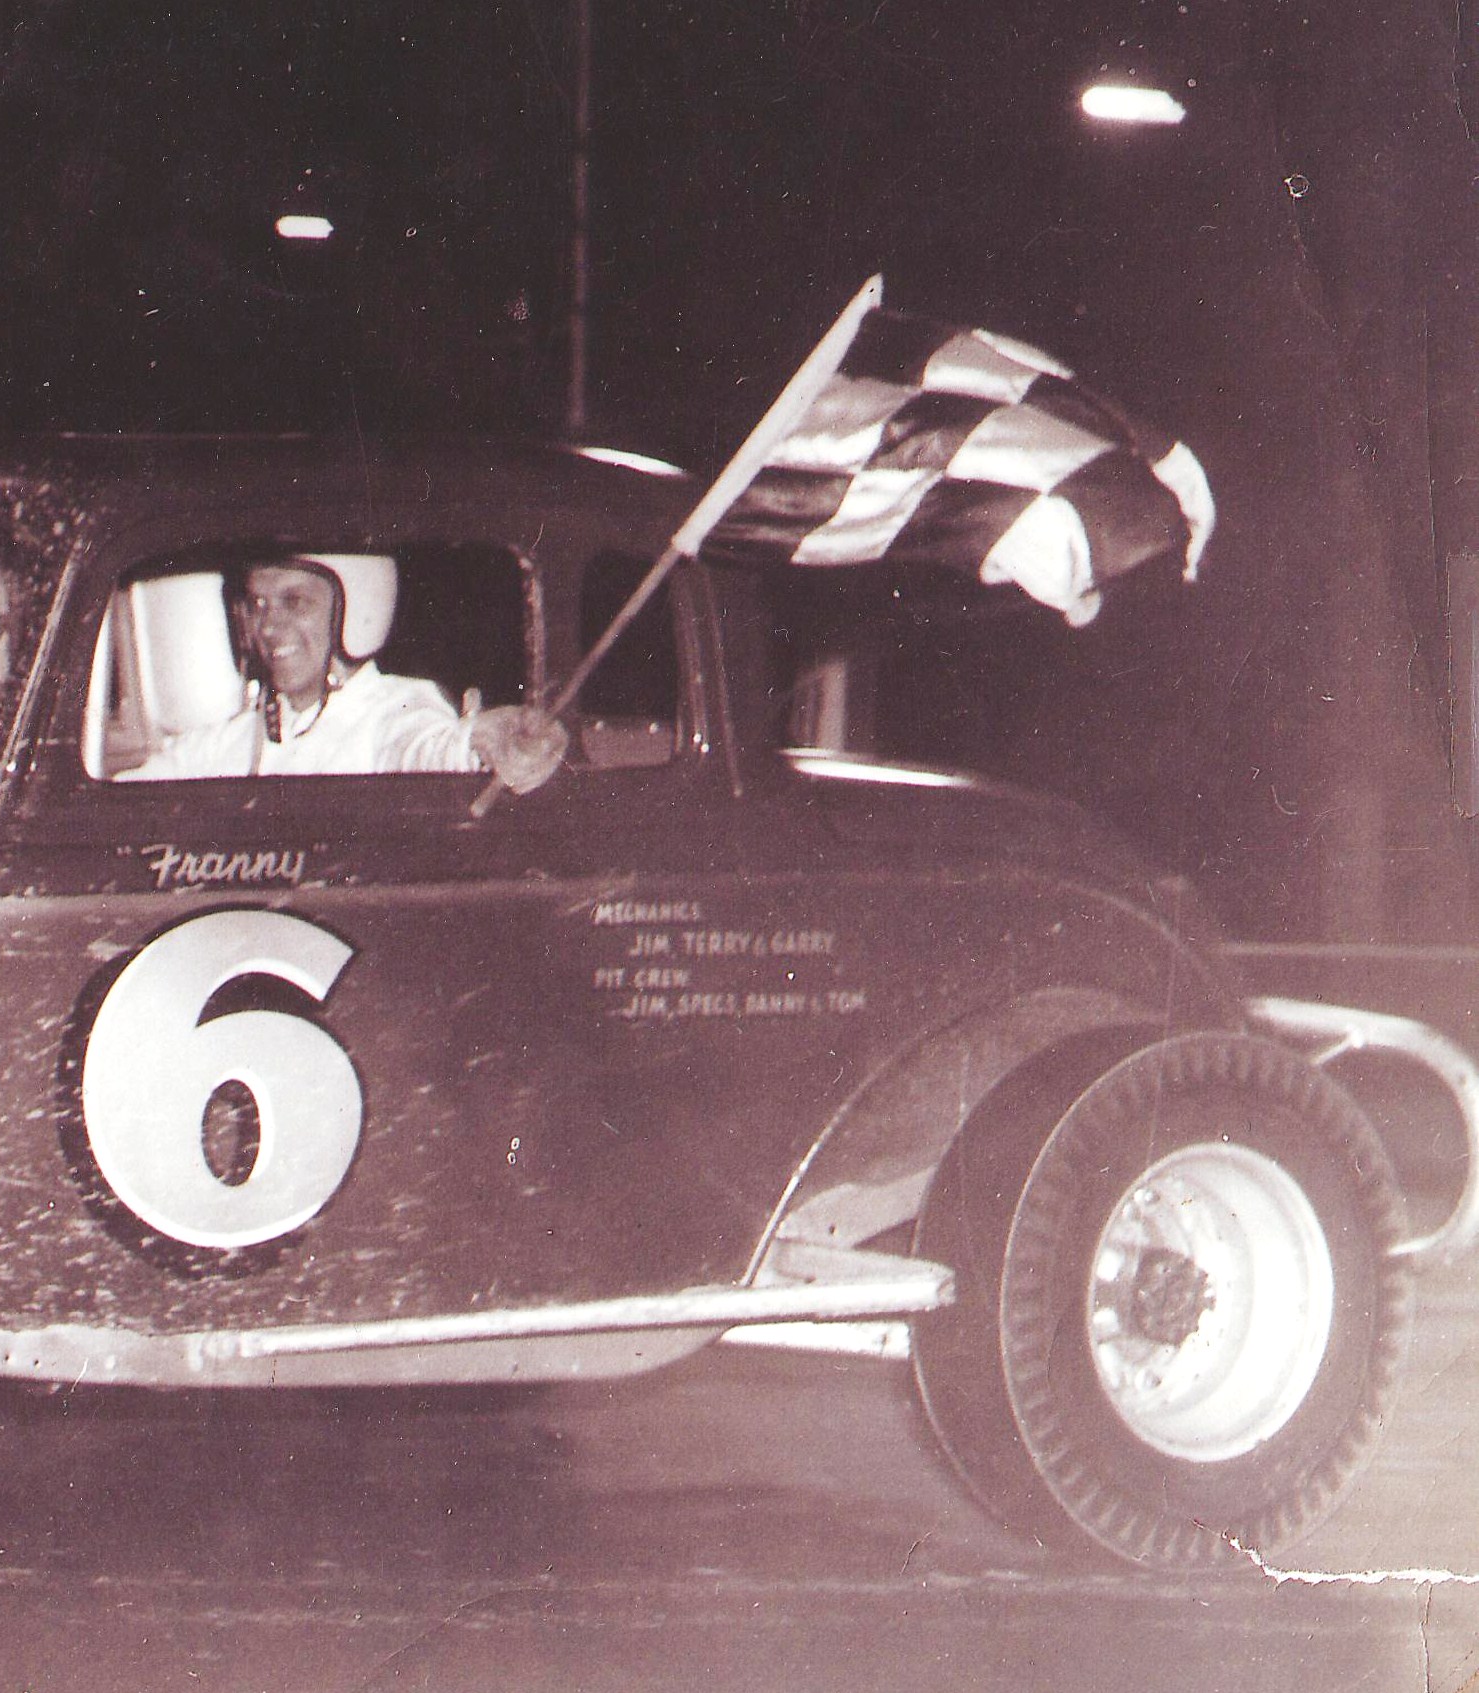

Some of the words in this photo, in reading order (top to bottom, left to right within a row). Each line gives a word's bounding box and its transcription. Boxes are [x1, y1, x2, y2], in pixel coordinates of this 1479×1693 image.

[682, 930, 751, 955] TERRY
[594, 966, 625, 989] PIT
[633, 966, 691, 989] CREW
[82, 909, 364, 1249] 6
